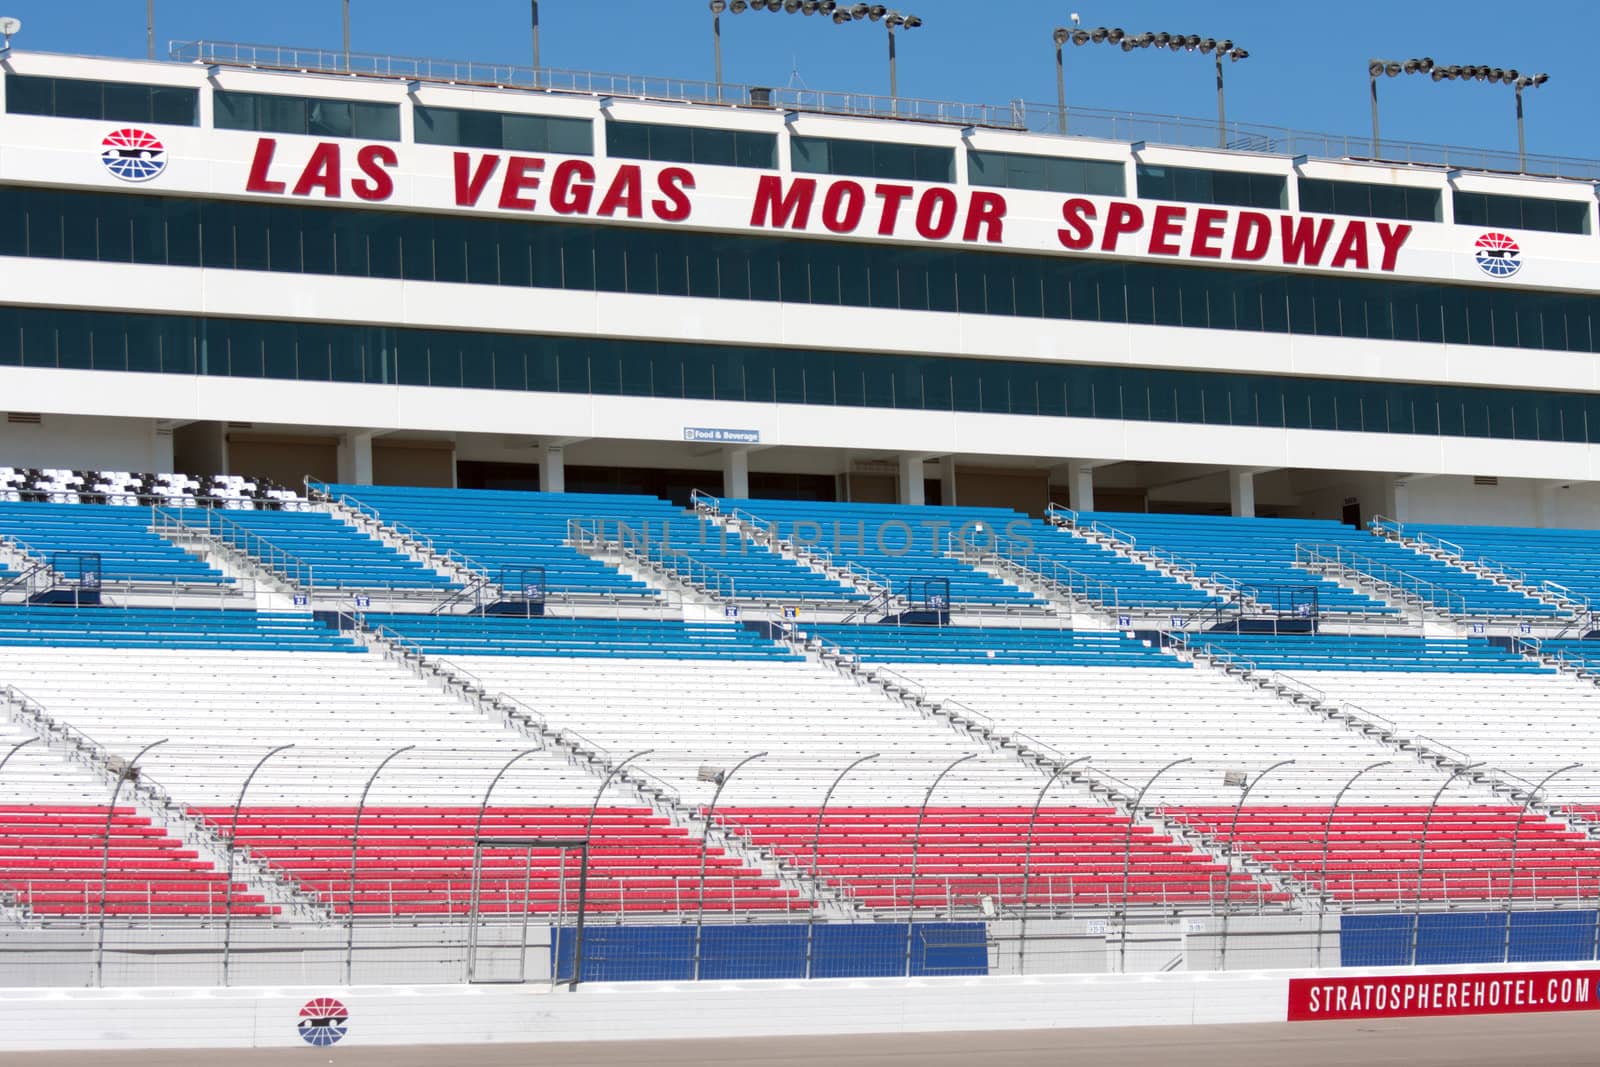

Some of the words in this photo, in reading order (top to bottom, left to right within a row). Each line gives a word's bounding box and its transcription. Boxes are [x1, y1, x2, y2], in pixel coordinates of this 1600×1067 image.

[246, 138, 398, 201] LAS
[453, 151, 695, 222] VEGAS
[749, 175, 1007, 244] MOTOR
[1057, 198, 1411, 271] SPEEDWAY
[695, 430, 713, 440] Food
[714, 431, 722, 440] &
[723, 431, 758, 442] Beverage
[1308, 977, 1590, 1013] STRATOSPHEREHOTEL.COM
